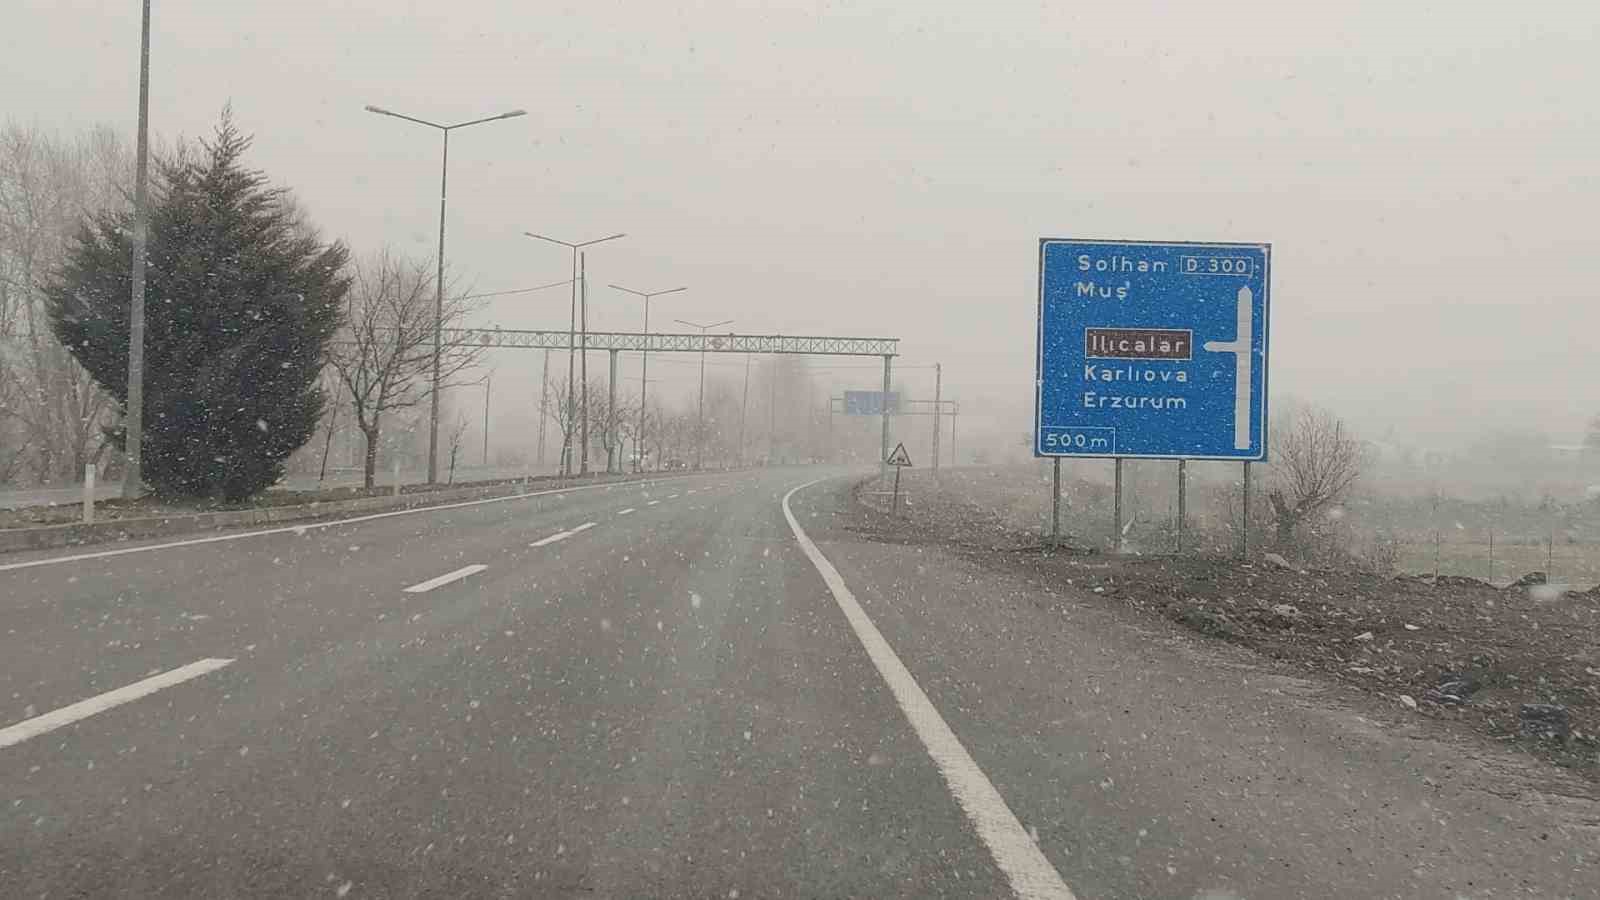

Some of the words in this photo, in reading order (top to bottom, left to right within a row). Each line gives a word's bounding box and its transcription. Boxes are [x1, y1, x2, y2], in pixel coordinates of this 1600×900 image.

[1078, 254, 1168, 272] Solhan
[1187, 258, 1198, 272] D
[1208, 259, 1247, 273] 300
[1077, 281, 1128, 302] Muş
[1084, 364, 1187, 382] Karlıova
[1084, 392, 1187, 409] Erzurum
